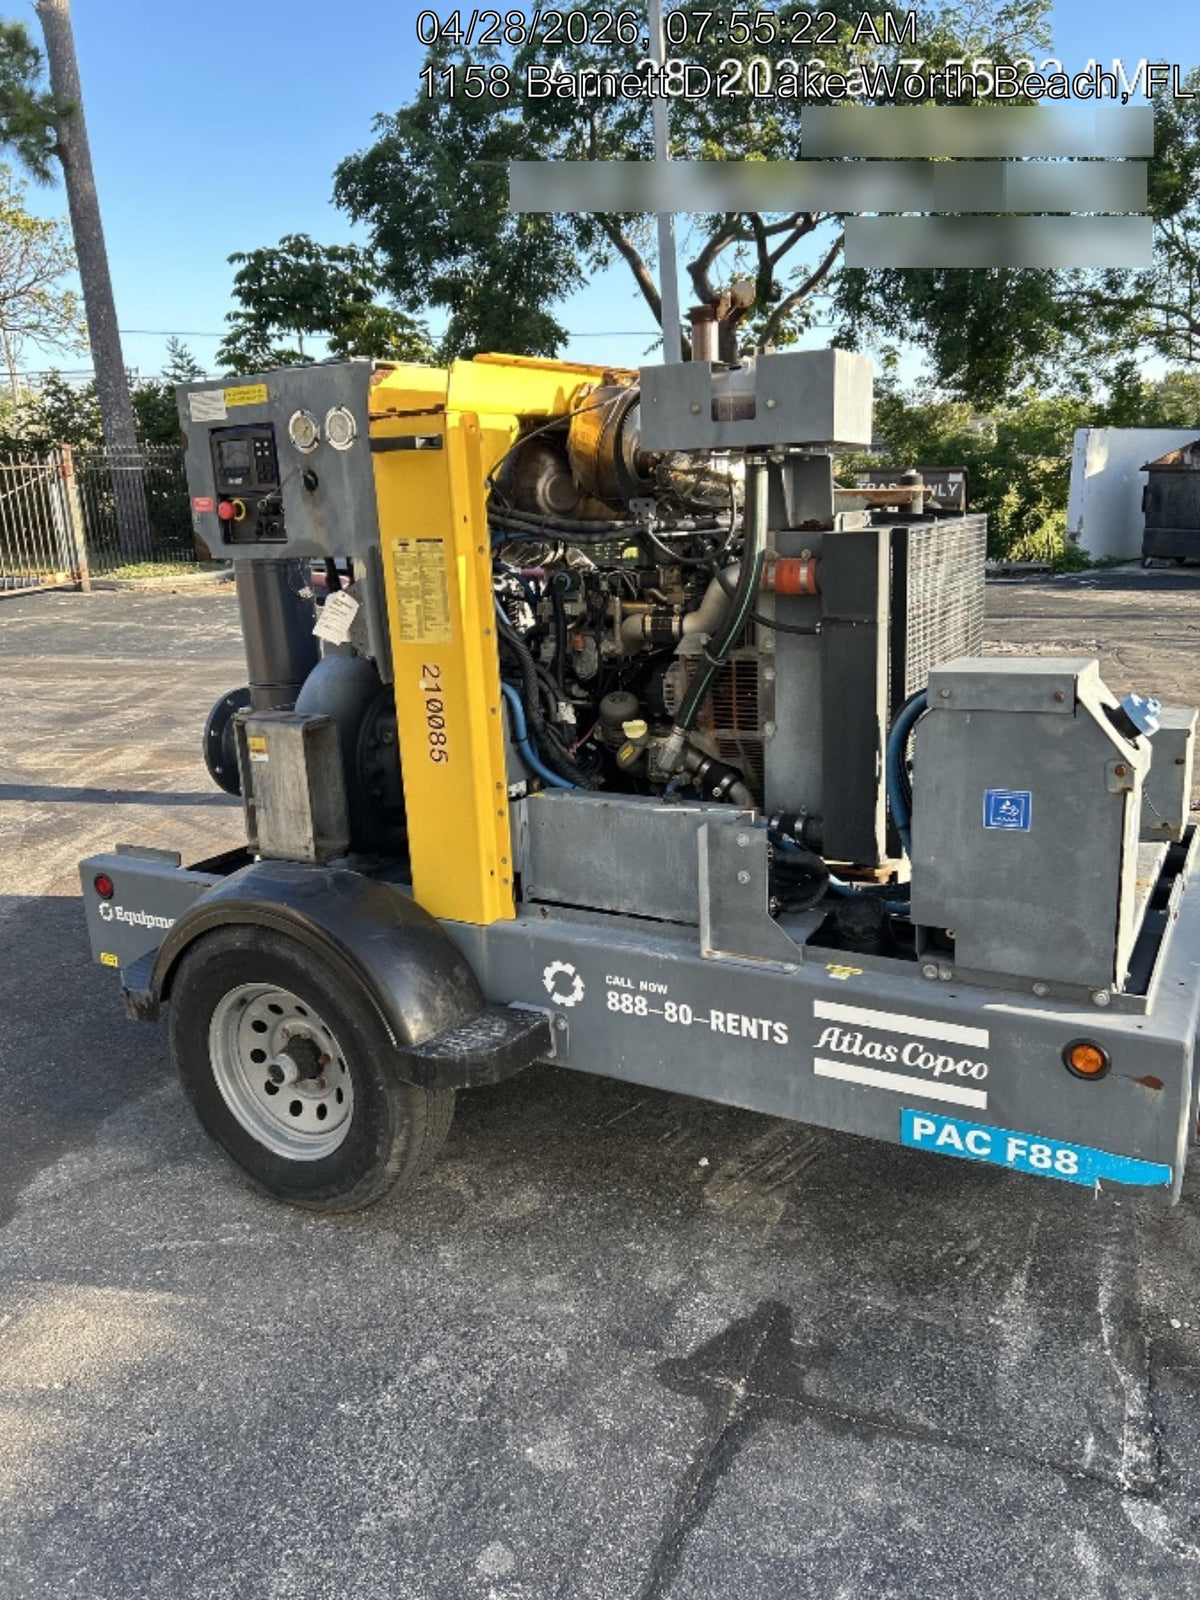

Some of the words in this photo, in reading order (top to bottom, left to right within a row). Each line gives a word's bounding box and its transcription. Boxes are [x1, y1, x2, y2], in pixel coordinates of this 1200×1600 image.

[419, 664, 448, 763] 210085
[605, 975, 635, 989] CALL
[639, 981, 668, 995] NOW
[606, 990, 789, 1045] 888-80-RENTS
[812, 1026, 899, 1062] Atlas
[901, 1042, 989, 1079] Copco
[912, 1116, 992, 1156] PAC
[1005, 1137, 1079, 1176] F88
